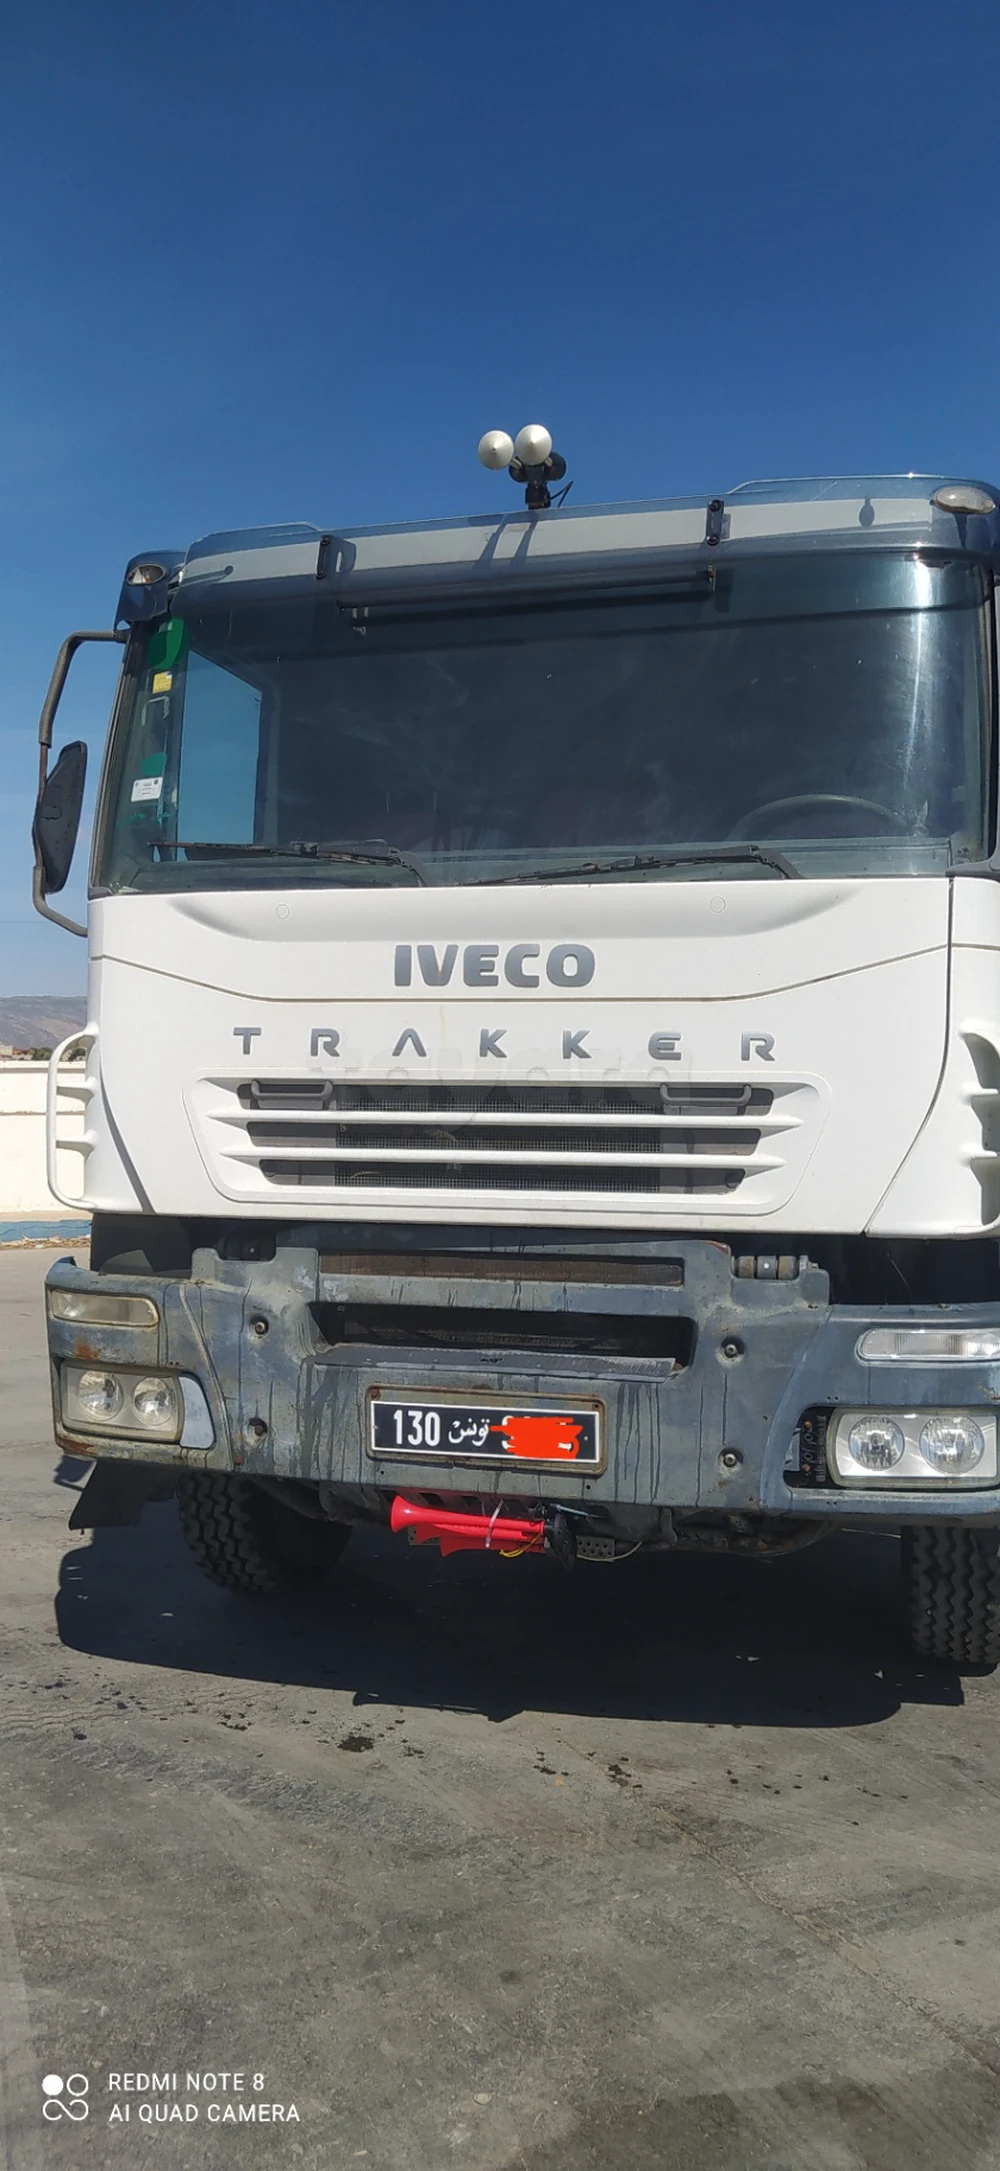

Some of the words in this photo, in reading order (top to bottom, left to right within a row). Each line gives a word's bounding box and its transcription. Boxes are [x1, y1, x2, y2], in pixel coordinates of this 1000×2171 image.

[394, 943, 596, 988] IVECO
[232, 1026, 776, 1062] TRAKKER
[393, 1409, 441, 1447] 130
[448, 1417, 491, 1447] تونس
